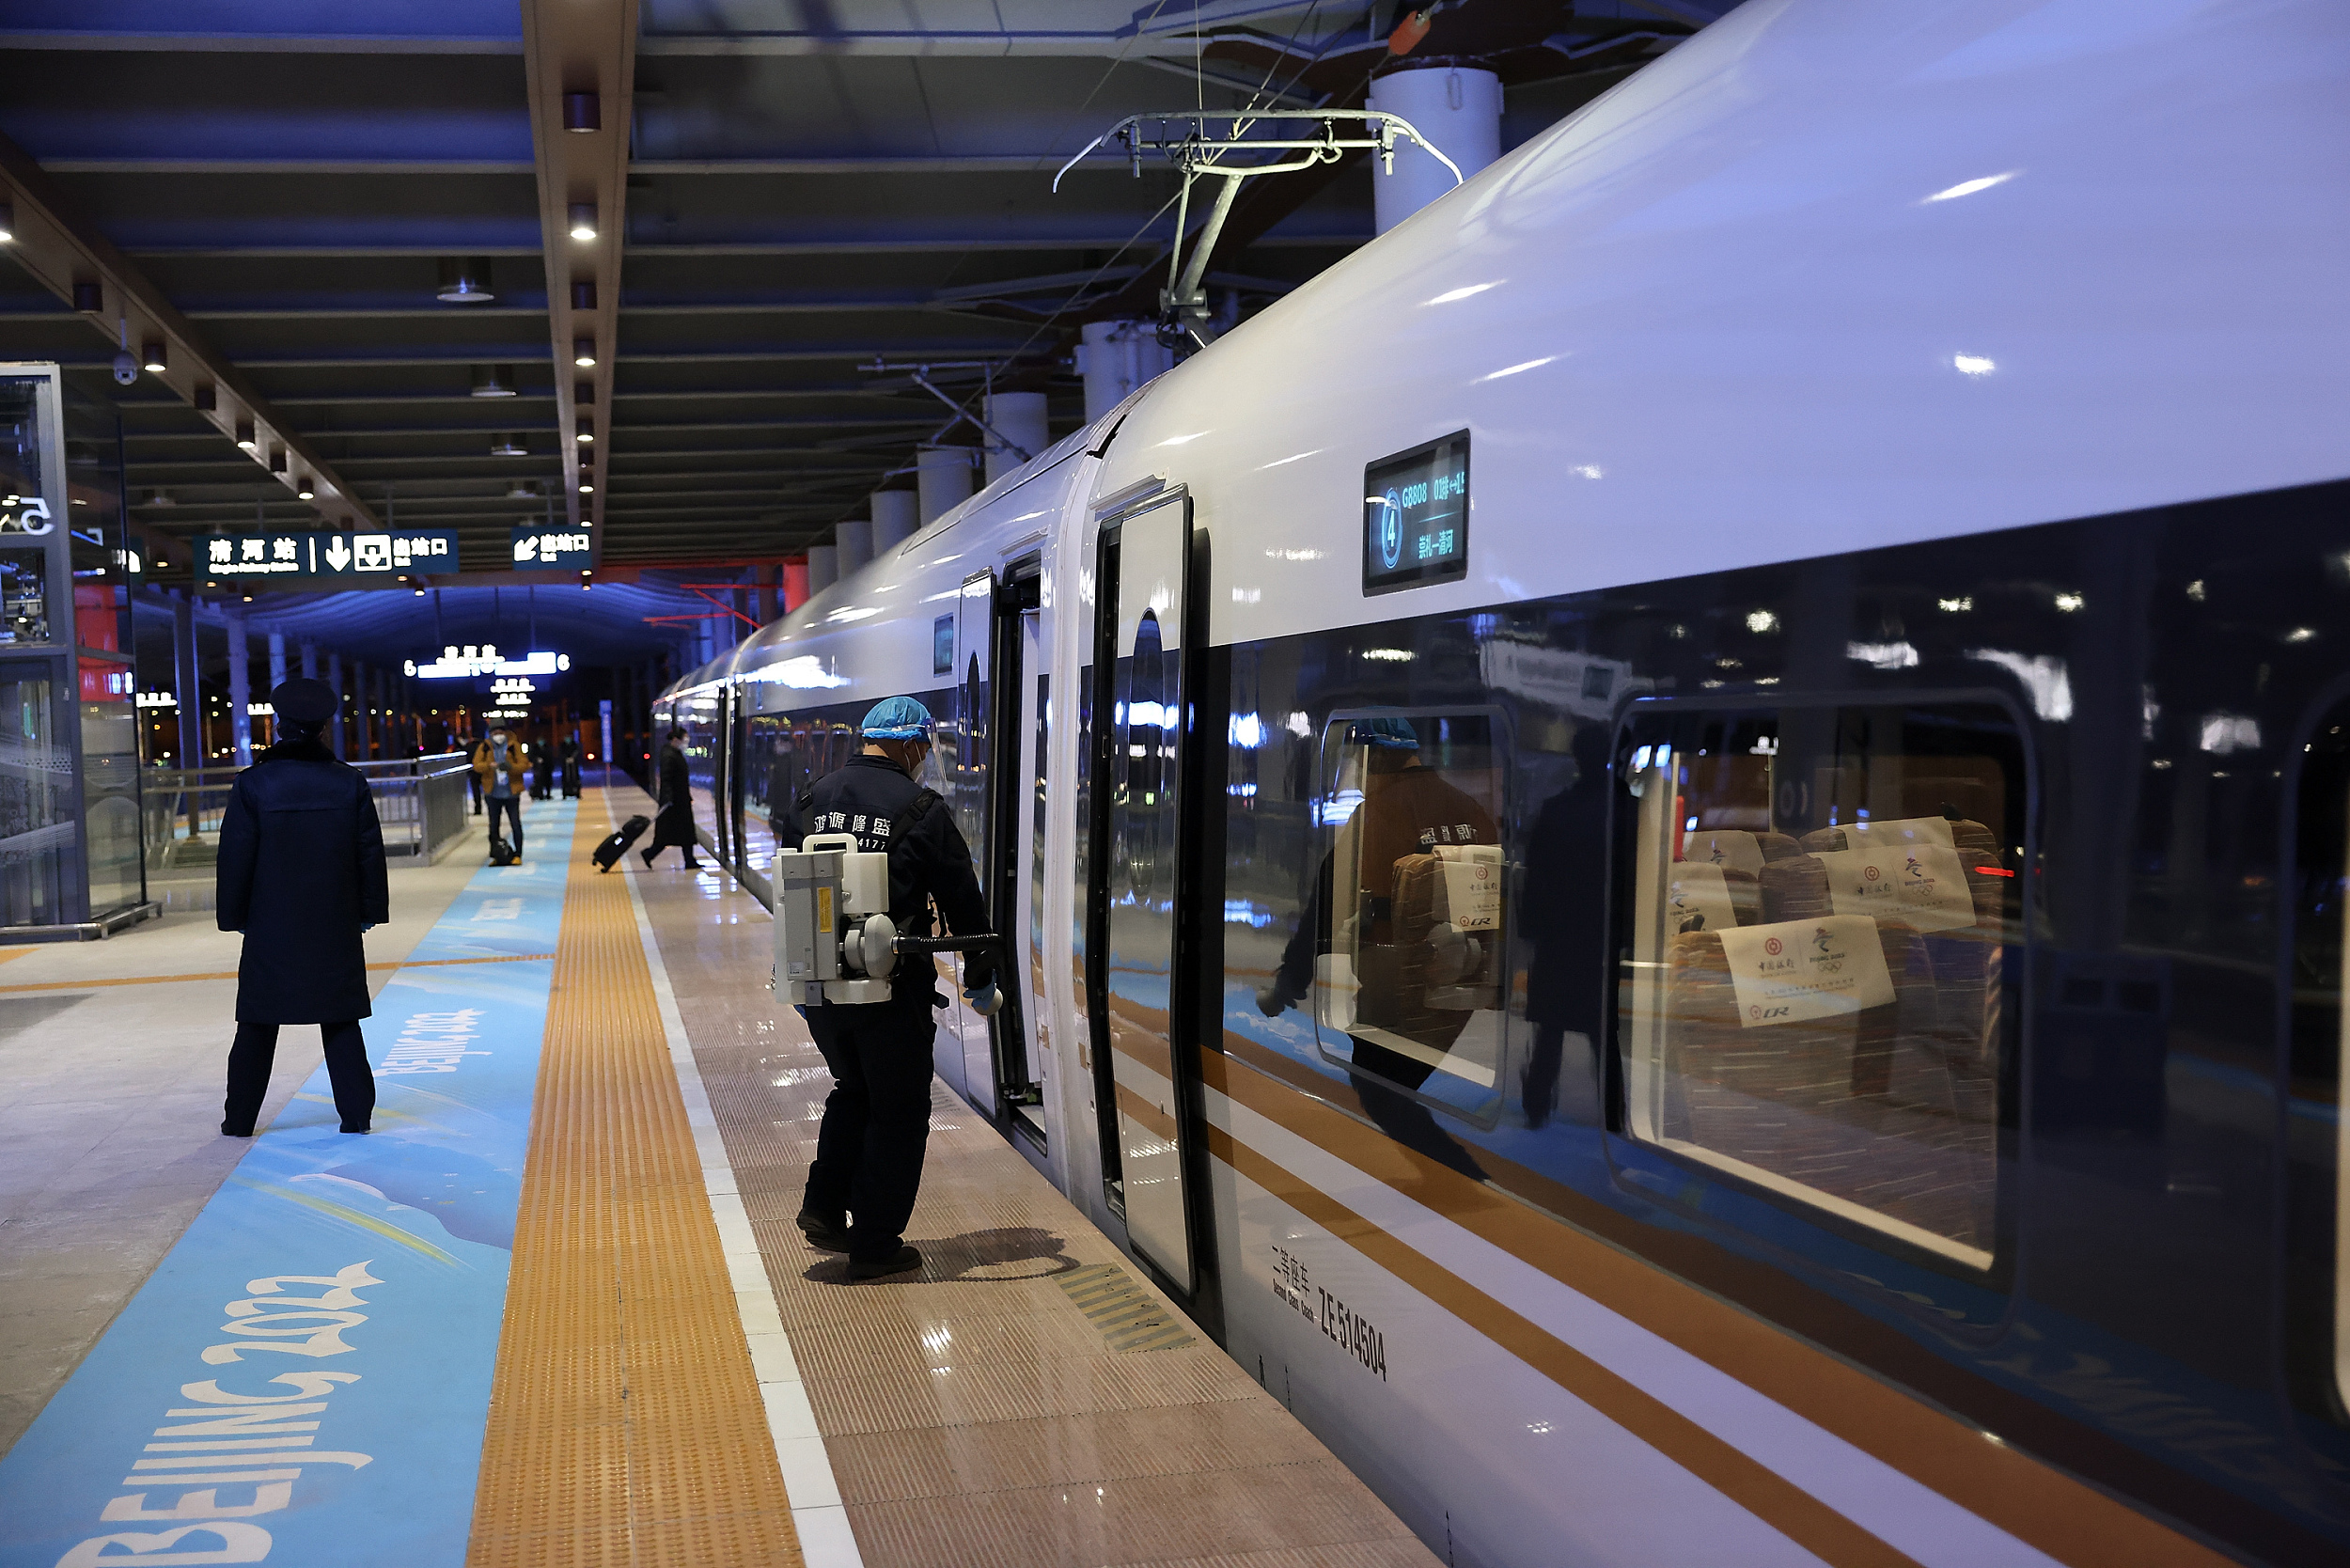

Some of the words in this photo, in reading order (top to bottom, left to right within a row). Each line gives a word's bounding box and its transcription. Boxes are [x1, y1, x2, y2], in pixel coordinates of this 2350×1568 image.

[1402, 482, 1427, 509] G8808
[1386, 510, 1396, 547] 4
[814, 811, 891, 837] 鸿源隆盛
[1272, 1245, 1310, 1298] 二等座车
[200, 1259, 386, 1366] 2022
[54, 1371, 374, 1568] BEIJING
